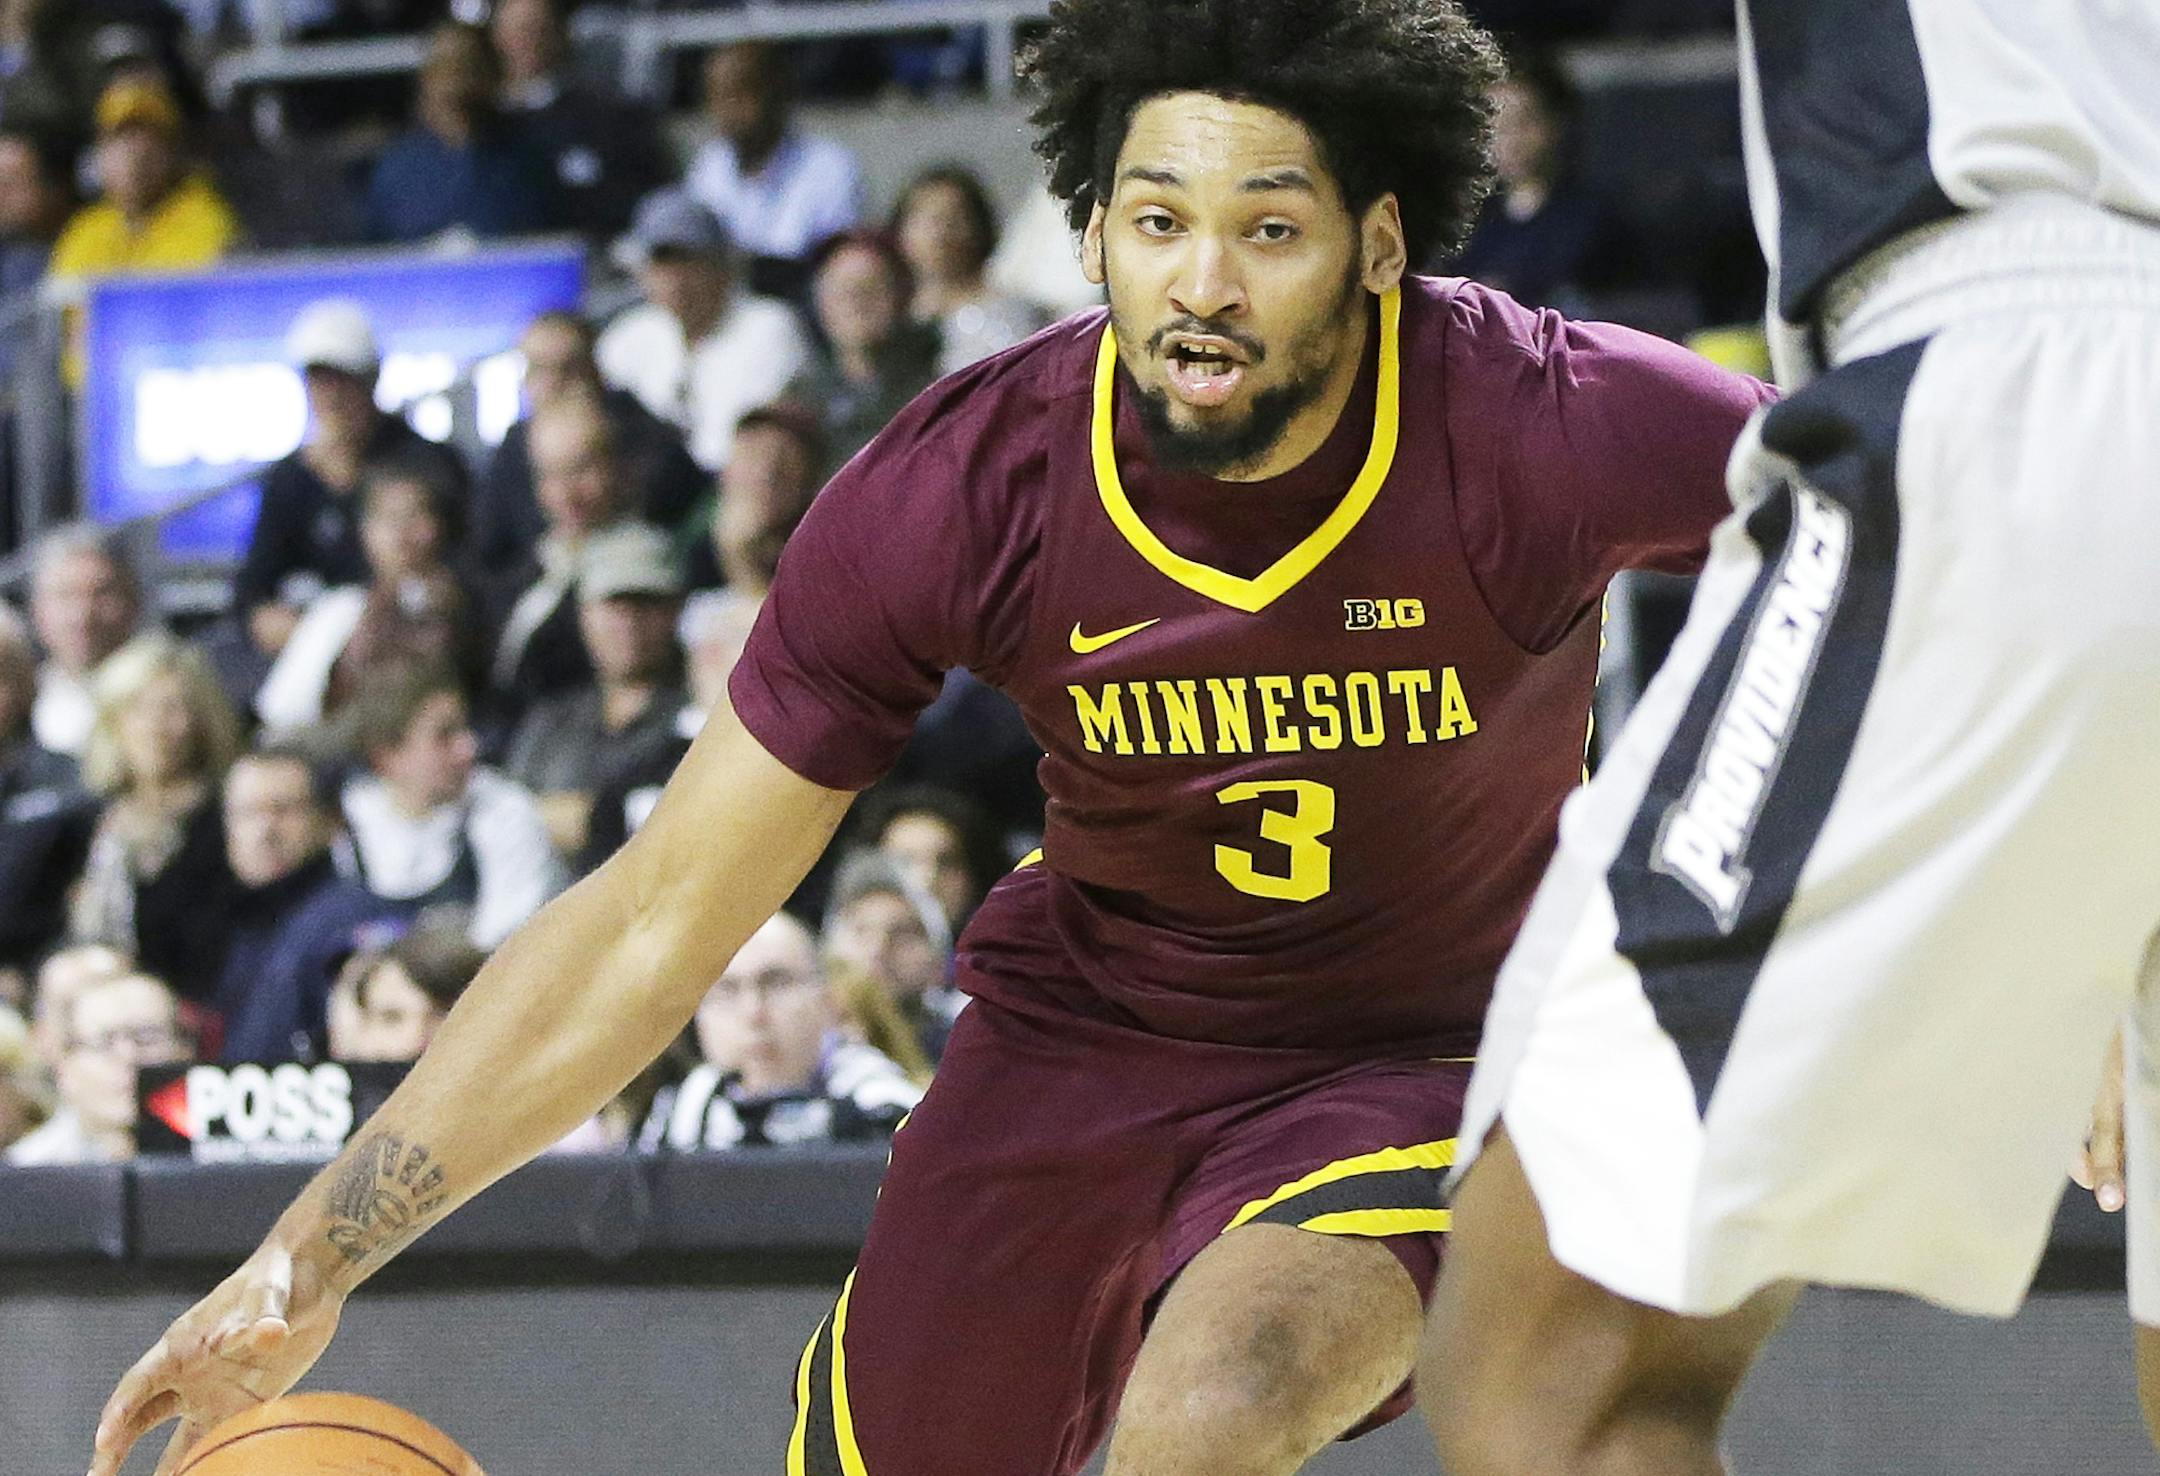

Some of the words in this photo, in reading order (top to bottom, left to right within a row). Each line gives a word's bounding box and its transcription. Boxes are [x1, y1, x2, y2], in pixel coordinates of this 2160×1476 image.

[1067, 667, 1478, 755] MINNESOTA
[1655, 487, 1851, 925] PROVIDENCE
[1215, 779, 1335, 902] 3
[185, 1061, 354, 1143] POSS
